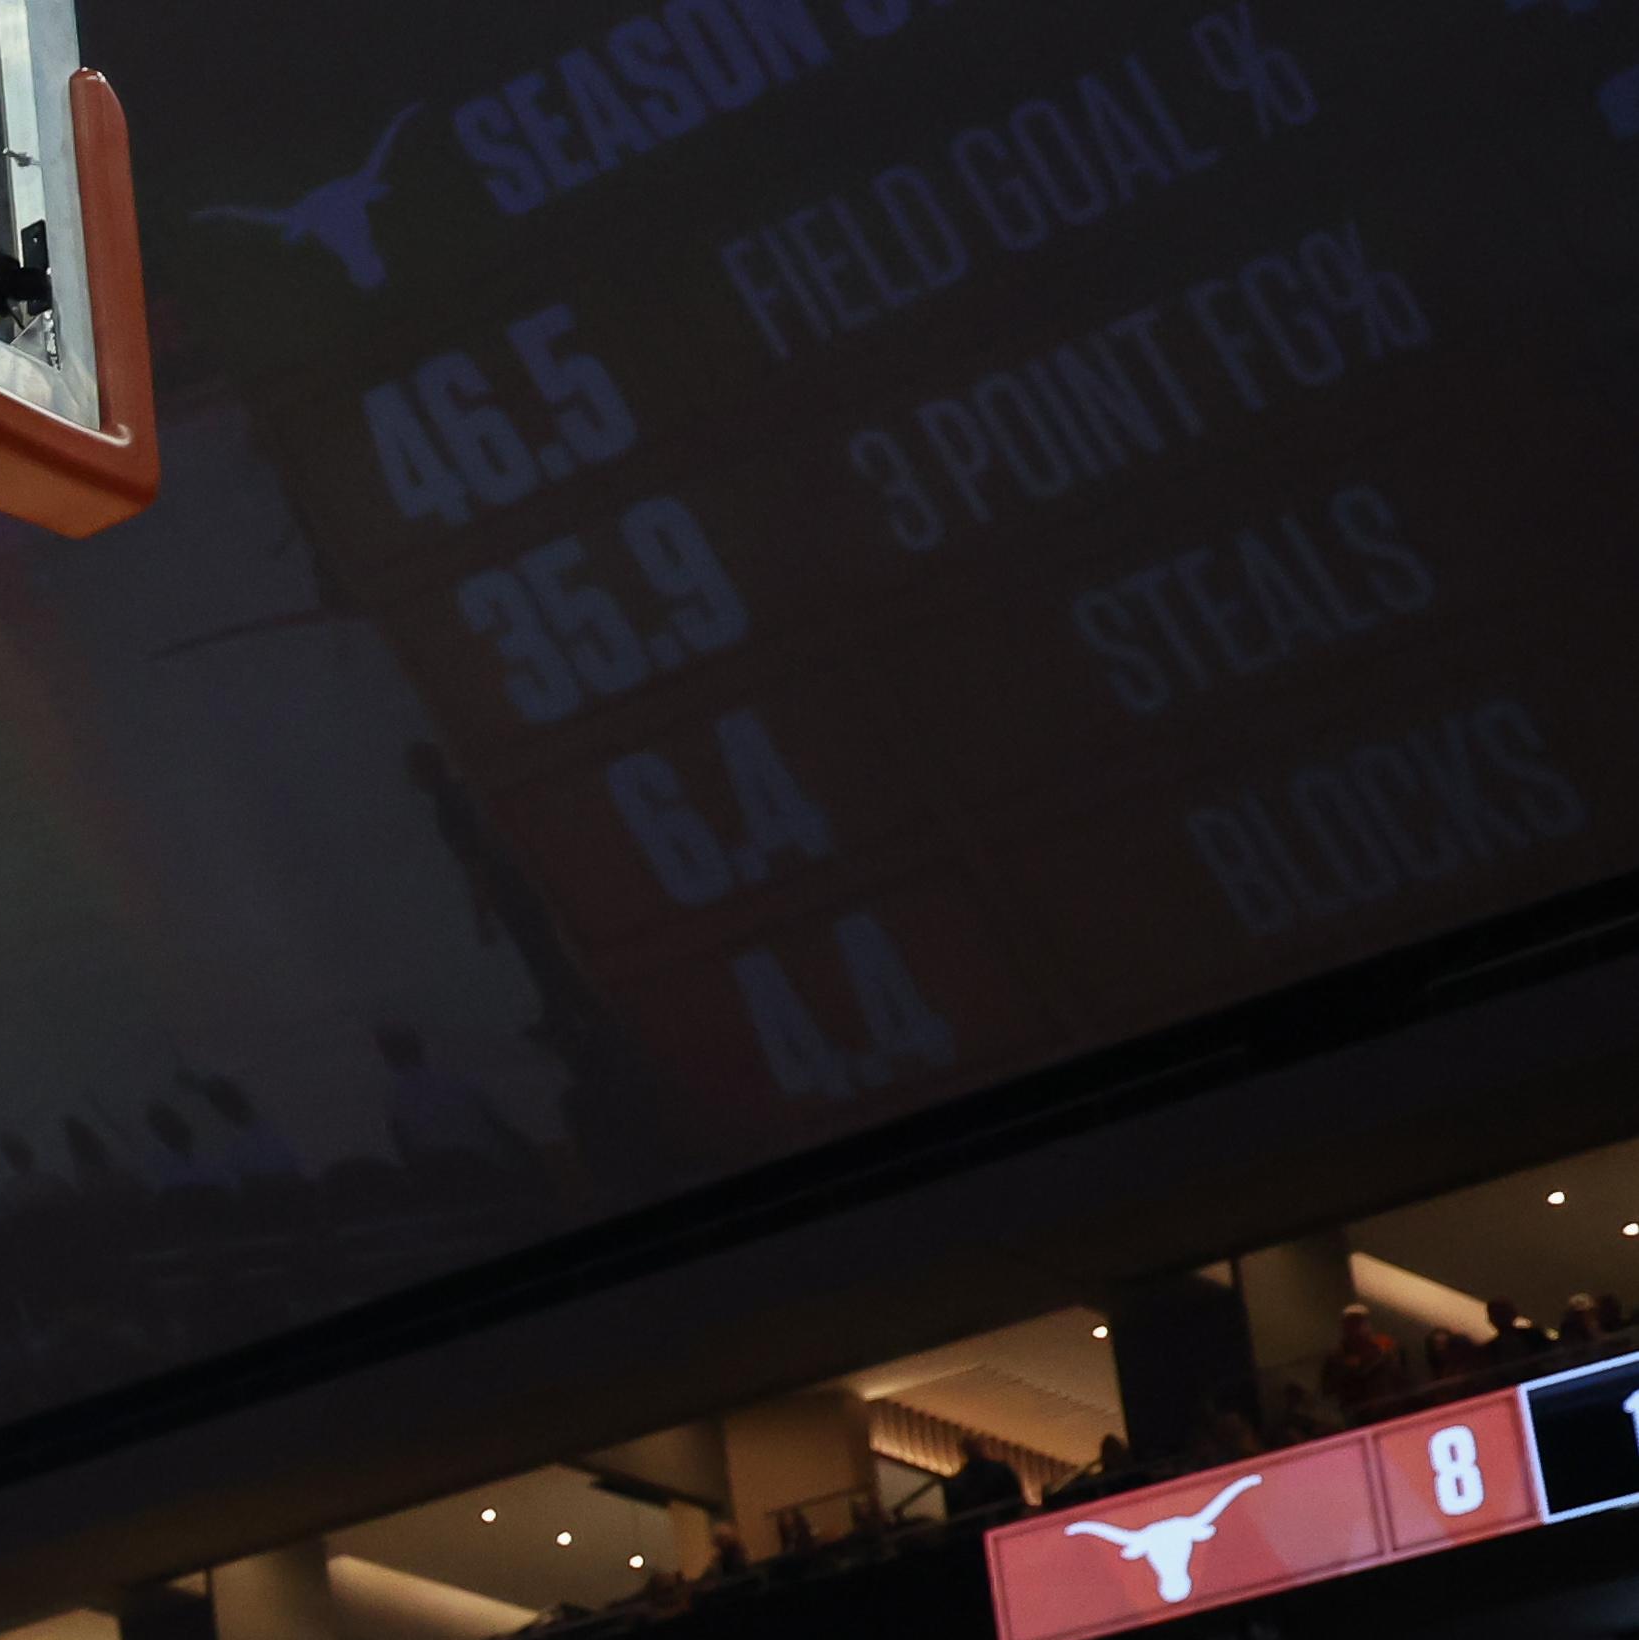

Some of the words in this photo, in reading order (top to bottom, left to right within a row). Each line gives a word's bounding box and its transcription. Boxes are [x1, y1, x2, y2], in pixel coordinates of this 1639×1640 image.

[451, 0, 833, 217] SEASON
[719, 165, 972, 361] FIELD
[949, 52, 1223, 253] GOAL
[1189, 2, 1319, 141] %
[362, 304, 639, 527] 46.5
[847, 428, 948, 553] 3
[915, 307, 1207, 526] POINT
[1184, 220, 1433, 413] FG%
[456, 495, 751, 724] 35.9
[1071, 483, 1439, 718] STEALS
[606, 706, 835, 909] 6.4
[1186, 696, 1590, 938] BLOCKS
[1428, 1423, 1486, 1517] 8
